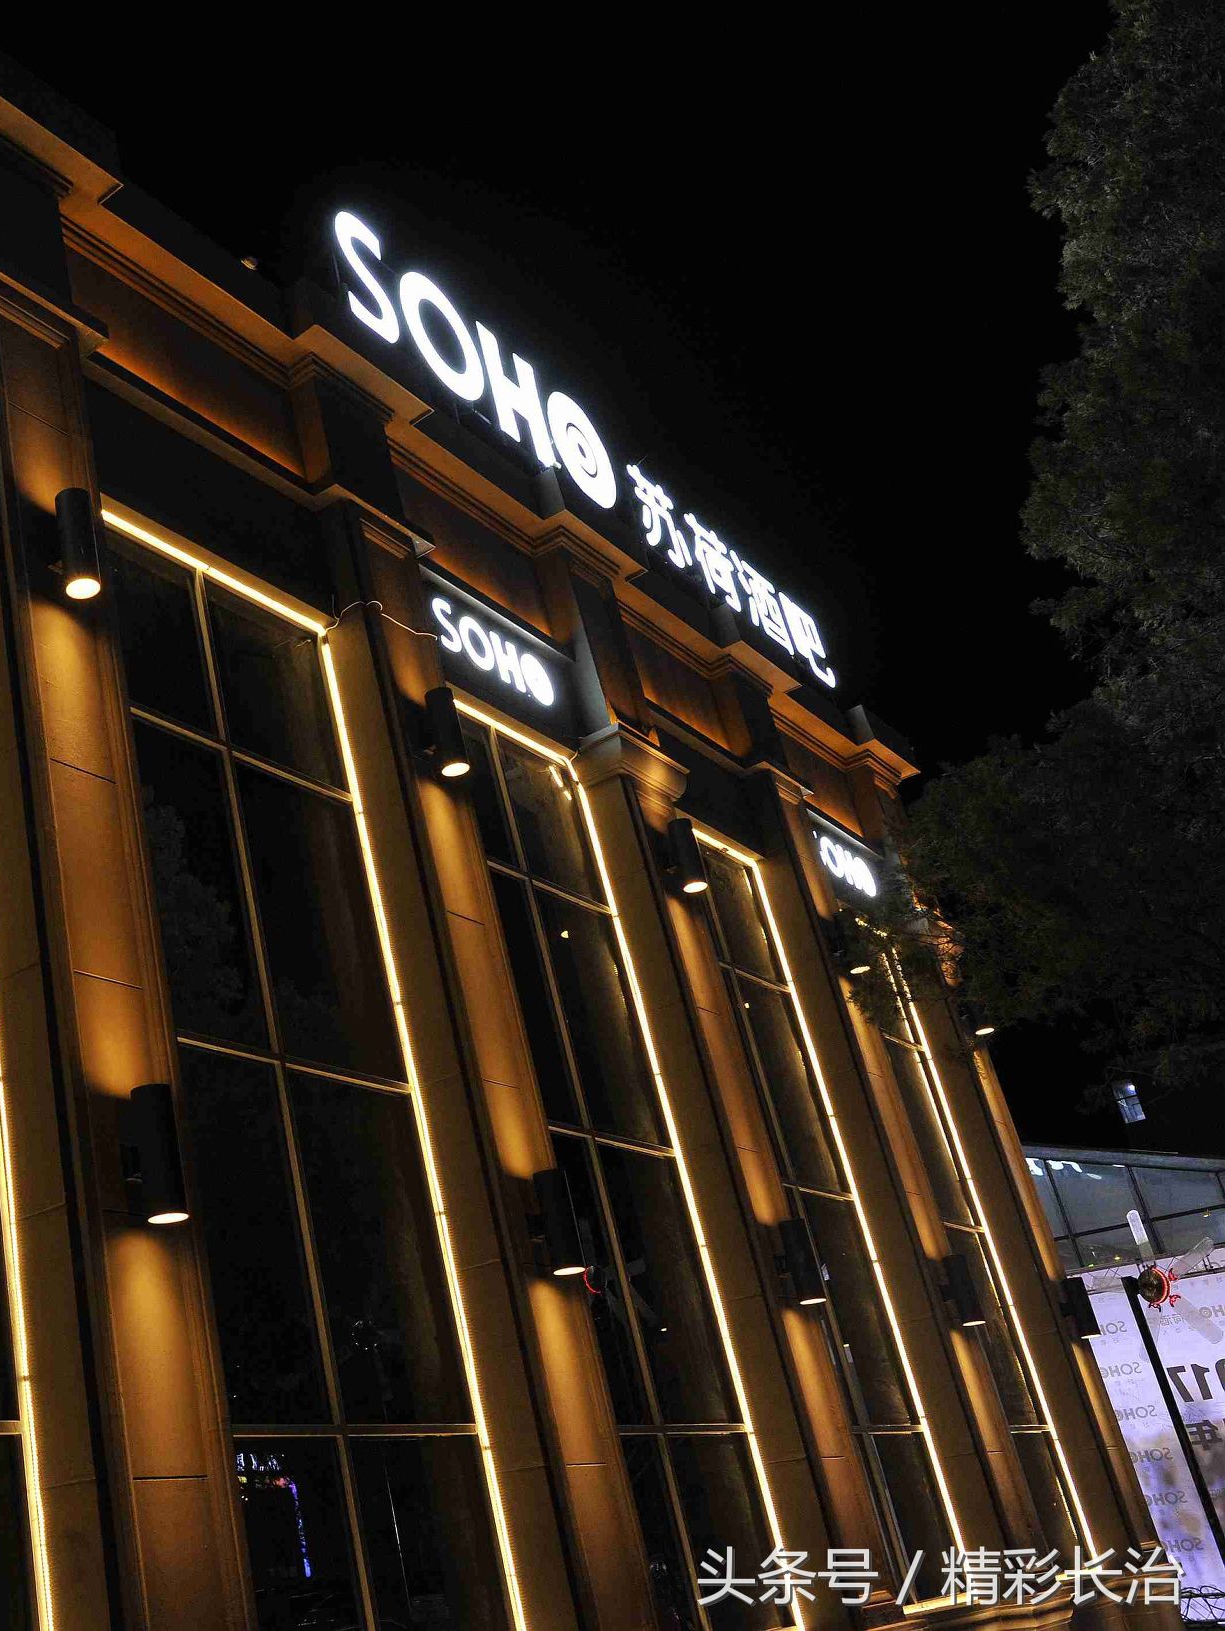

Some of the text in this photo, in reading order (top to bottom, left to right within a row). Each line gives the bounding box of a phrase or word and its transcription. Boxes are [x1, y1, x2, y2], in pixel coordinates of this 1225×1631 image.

[334, 211, 616, 509] SOHO
[431, 597, 554, 706] SOHO
[626, 464, 836, 688] 苏荷酒吧
[819, 836, 877, 897] OHO
